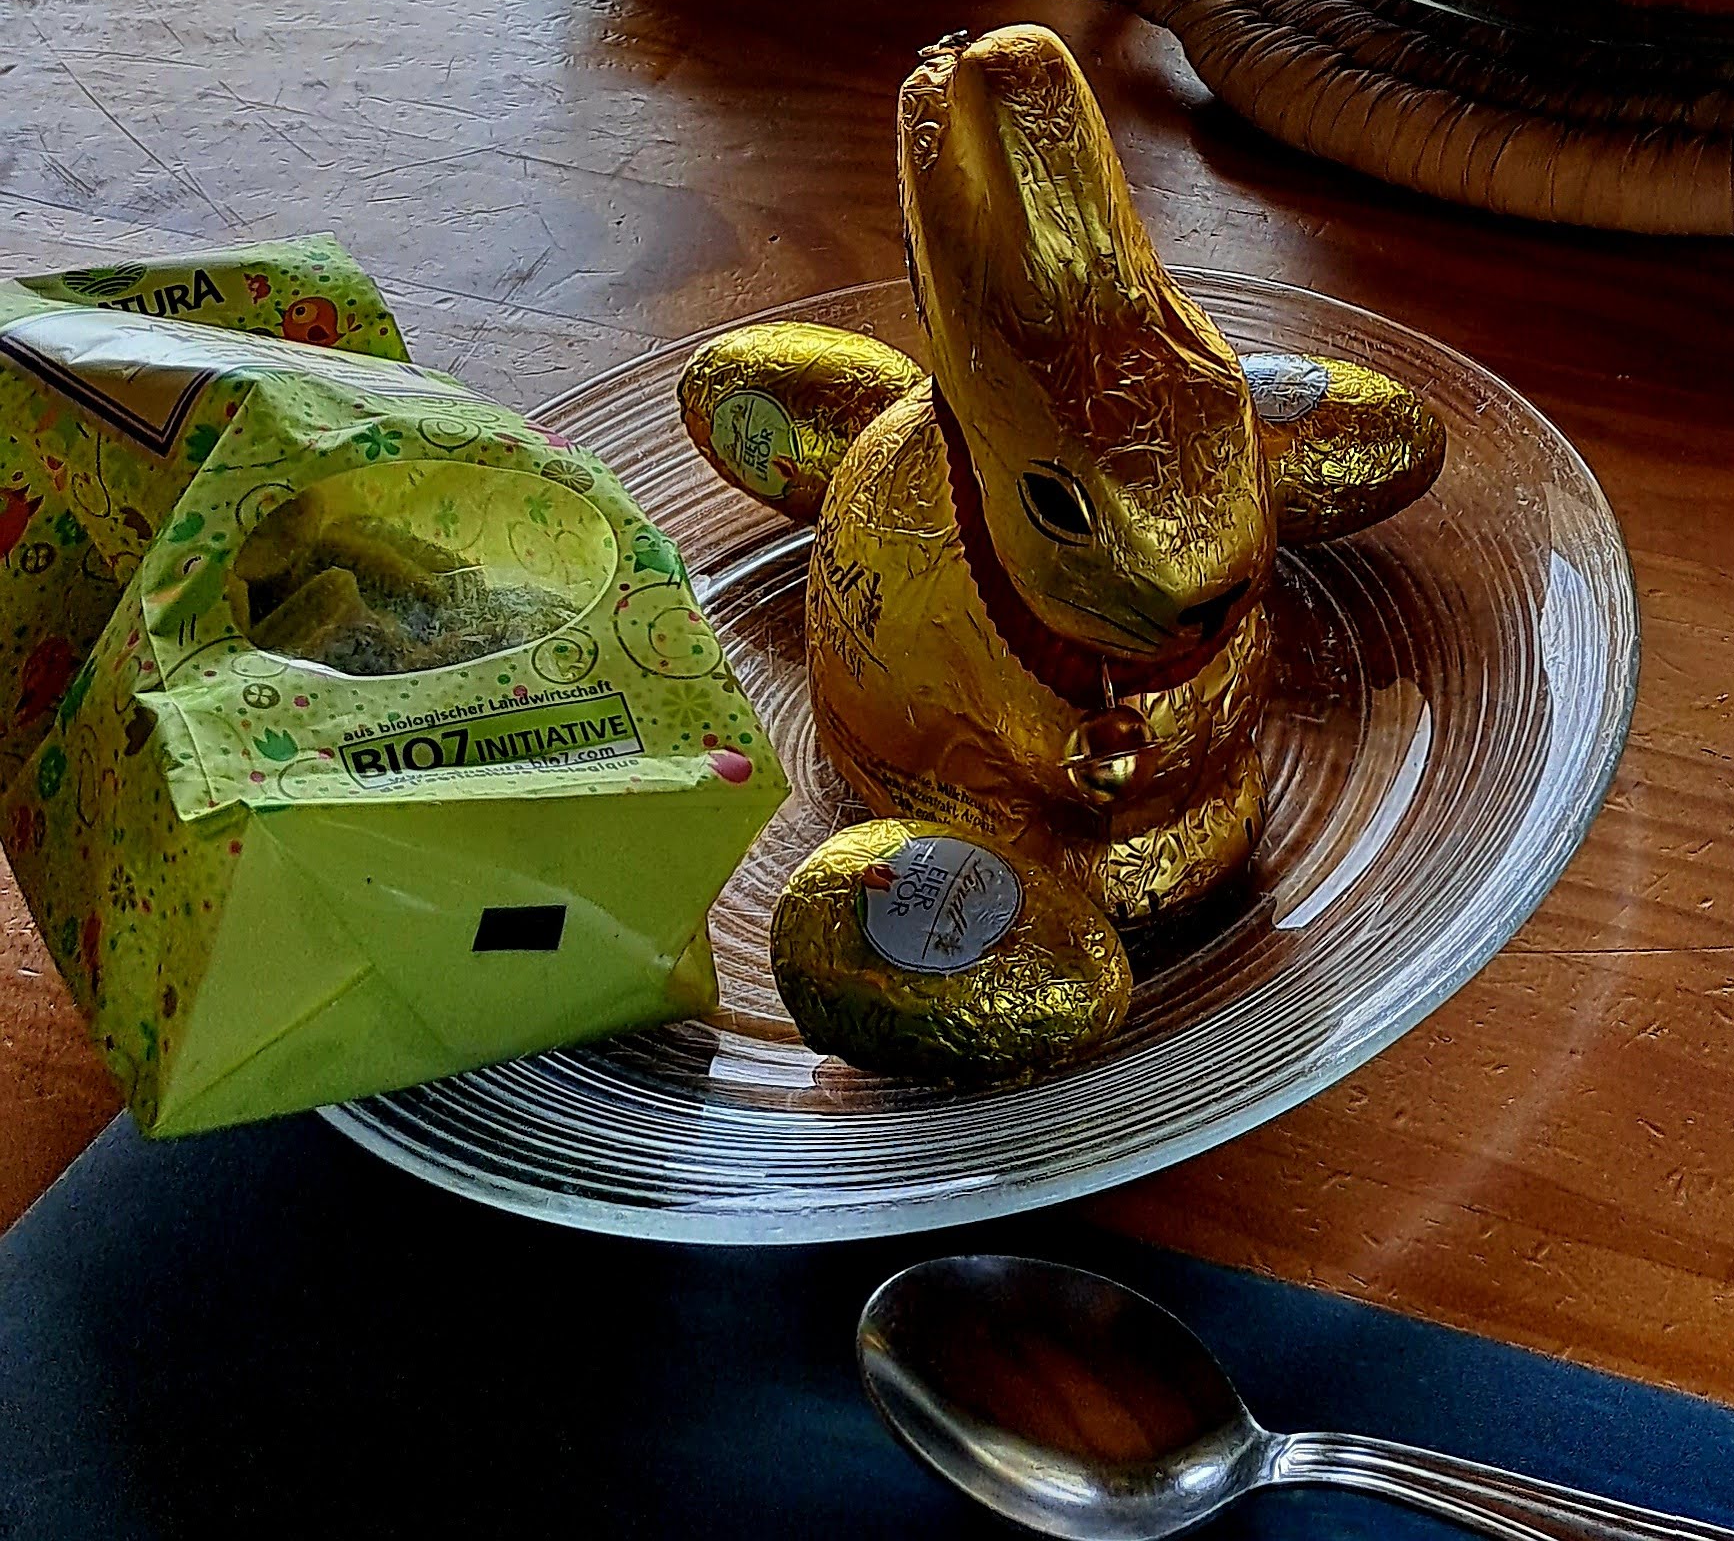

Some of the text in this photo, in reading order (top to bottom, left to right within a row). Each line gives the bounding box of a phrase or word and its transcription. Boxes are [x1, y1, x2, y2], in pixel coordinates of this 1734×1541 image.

[342, 678, 614, 743] aus biologischer Landwirtschaft
[475, 714, 628, 763] INITIATIVE
[920, 864, 950, 912] EIER
